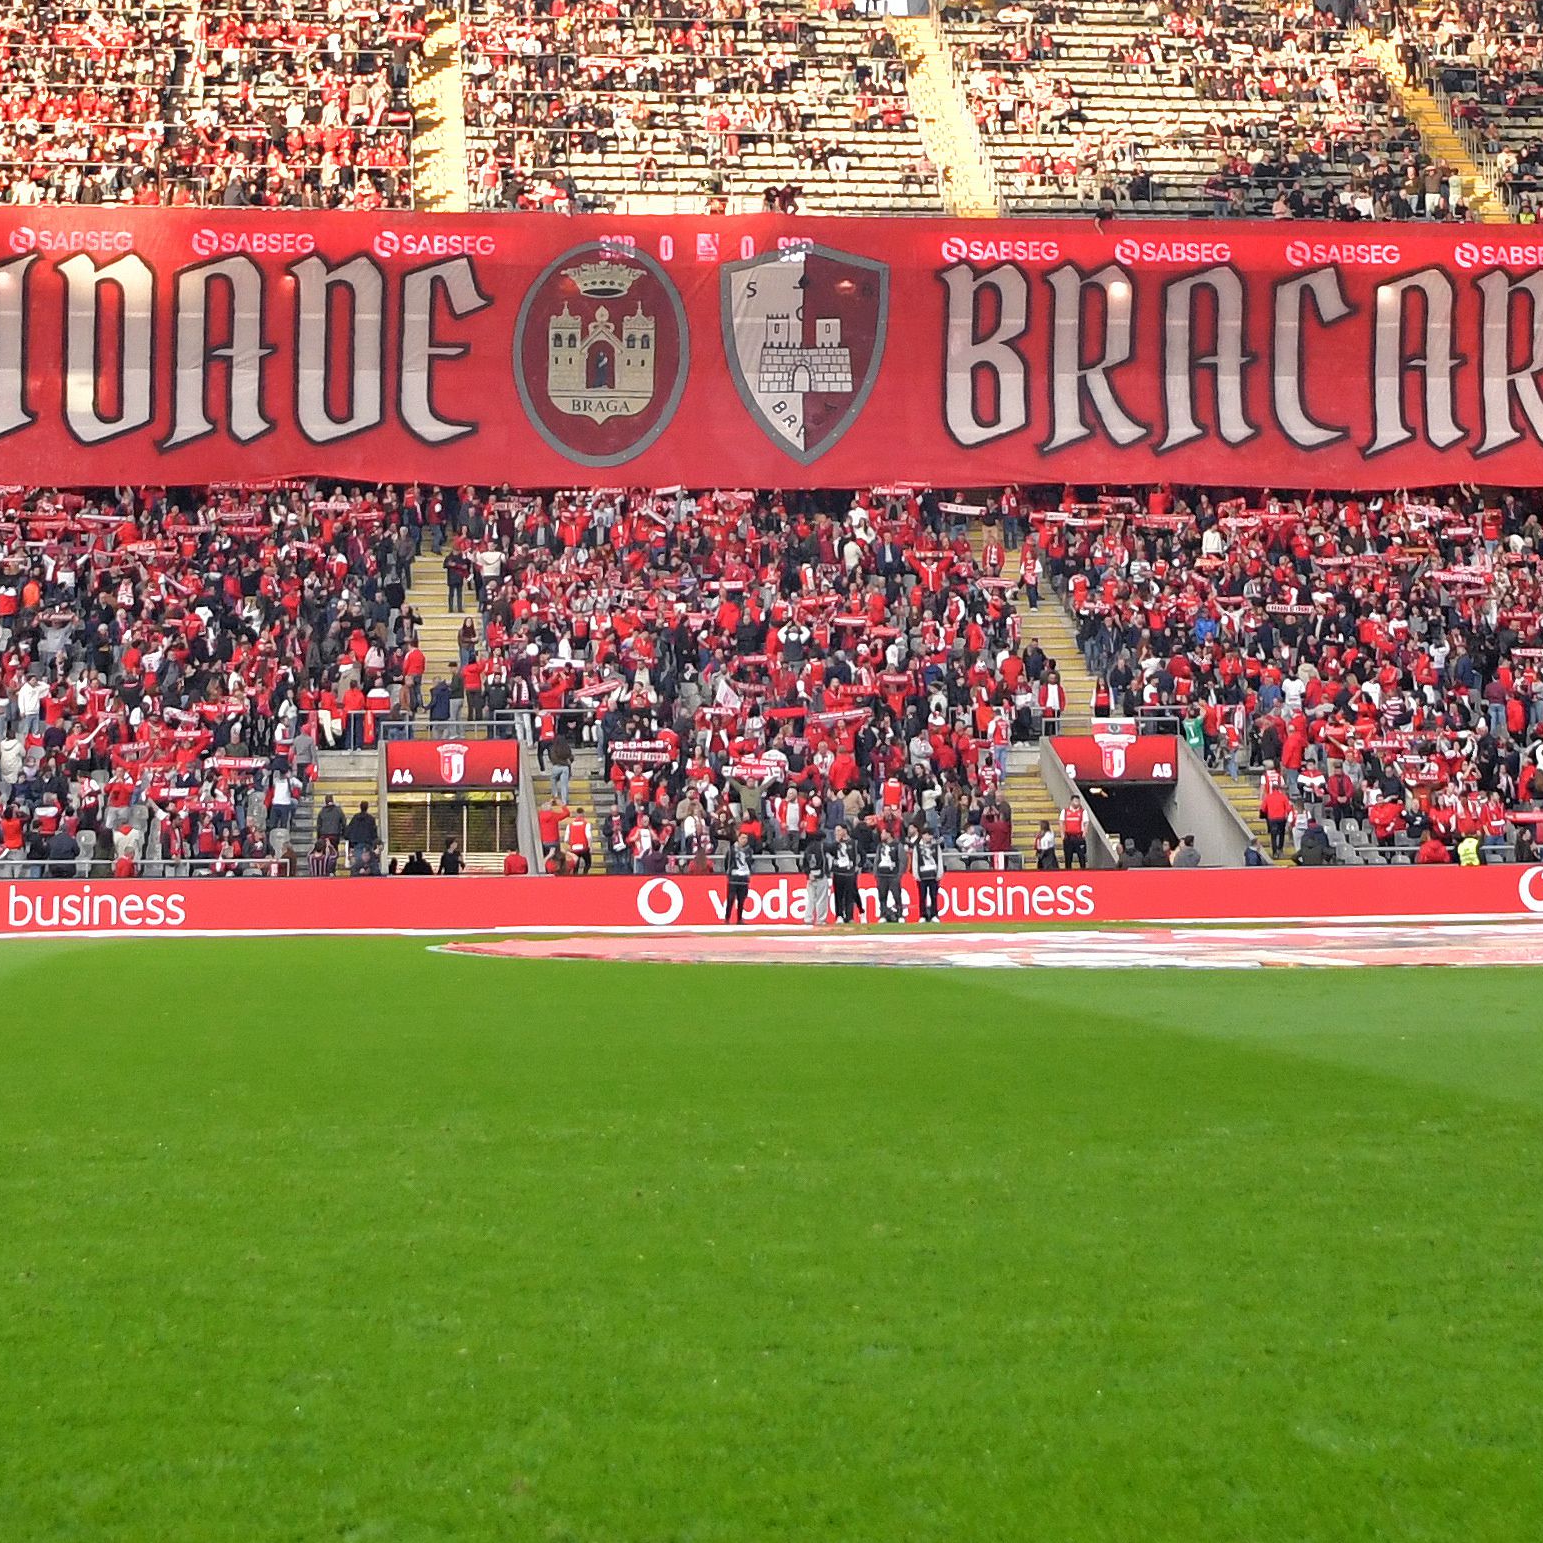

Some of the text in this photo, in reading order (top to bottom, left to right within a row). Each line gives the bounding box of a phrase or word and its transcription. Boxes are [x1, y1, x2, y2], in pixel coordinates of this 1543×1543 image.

[39, 229, 133, 252] SABSEG
[221, 231, 315, 254] SABSEG
[402, 233, 495, 256] SABSEG
[968, 240, 1059, 263] SABSEG
[1142, 242, 1231, 264] SABSEG
[1312, 243, 1400, 265] SABSEG
[571, 399, 630, 413] BRAGA
[9, 885, 186, 927] business
